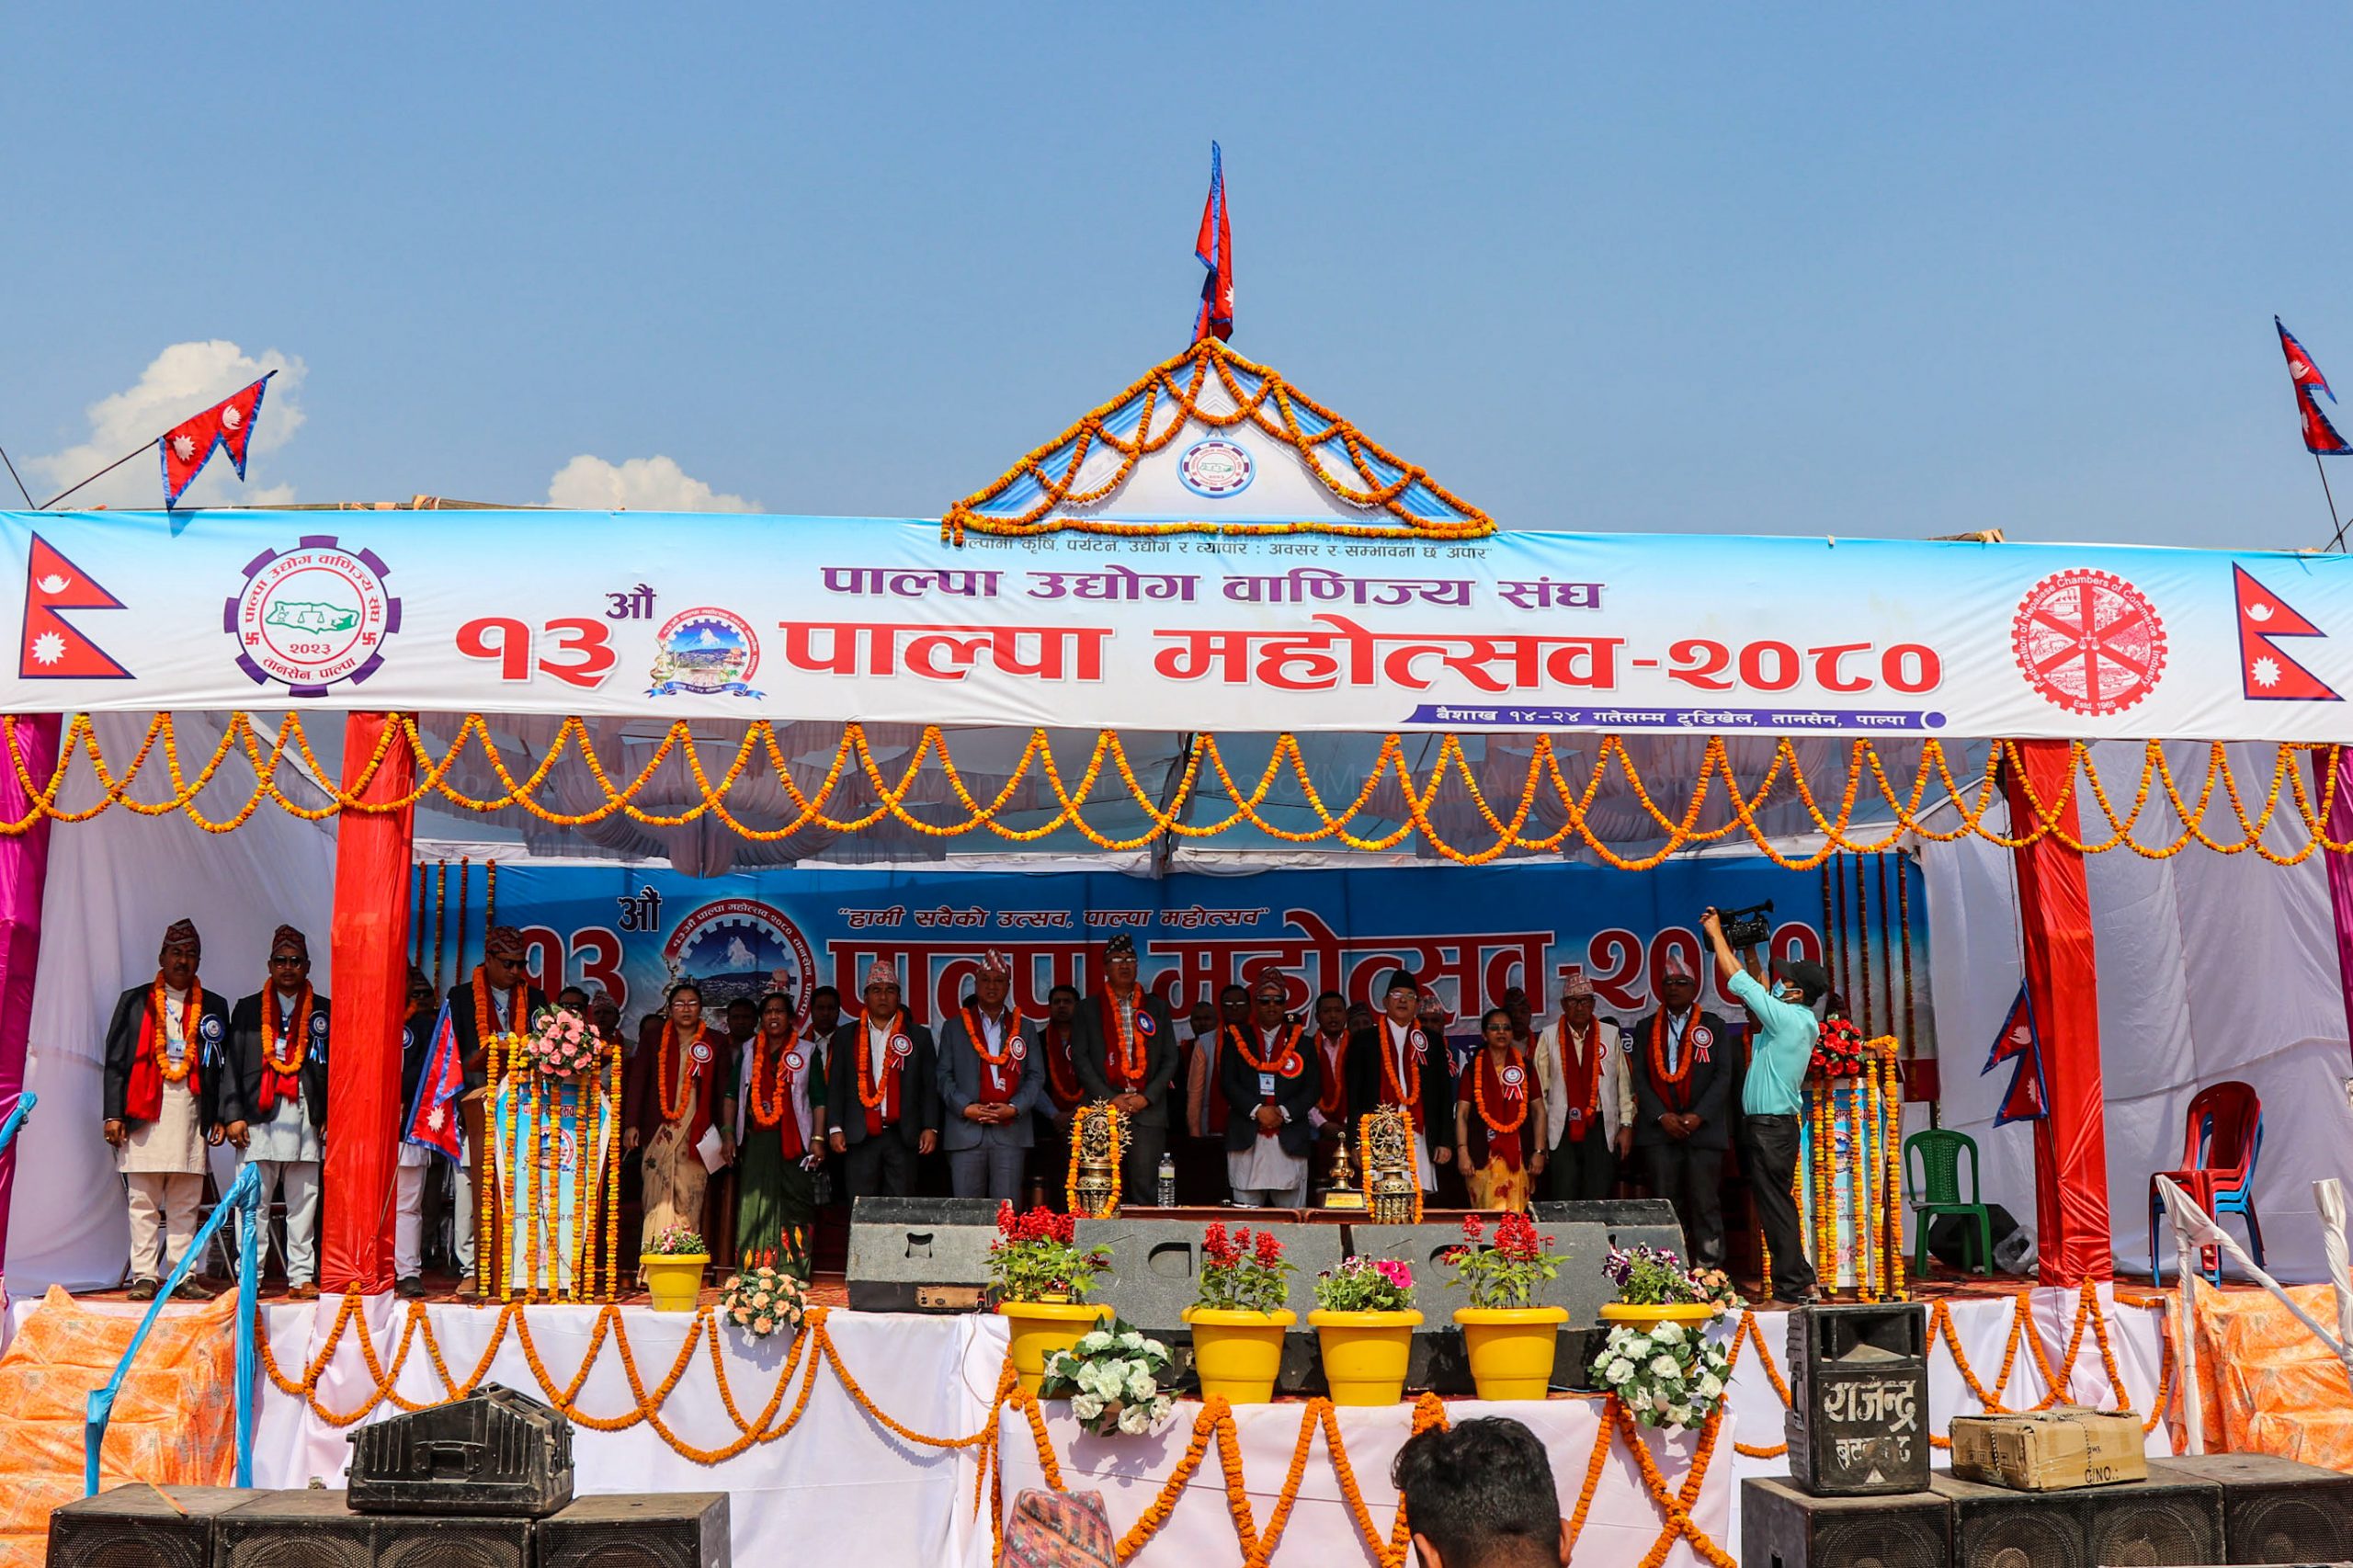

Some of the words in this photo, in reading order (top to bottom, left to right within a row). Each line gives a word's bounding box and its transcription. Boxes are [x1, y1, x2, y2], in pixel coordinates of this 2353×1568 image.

[1130, 538, 1171, 553] उद्योग
[1179, 541, 1189, 553] र
[1268, 544, 1319, 555] अवसर
[1345, 546, 1415, 557] सम्भावना
[1424, 546, 1438, 559] छ
[244, 580, 268, 624] पाल्पा
[267, 554, 313, 579] उद्योग
[318, 554, 374, 592] वाणिज्य
[369, 595, 381, 624] संघ
[821, 567, 1004, 597] पाल्पा
[1026, 564, 1201, 601] उद्योग
[1223, 567, 1476, 607] वाणिज्य
[1498, 576, 1606, 609] संघ
[2056, 575, 2109, 588] Chambers
[2110, 583, 2122, 593] of
[2021, 585, 2057, 619] Nepalese
[2122, 590, 2158, 637] Commerce
[2019, 619, 2029, 632] of
[290, 643, 332, 655] २०२३
[456, 617, 616, 687] १३
[779, 620, 1116, 682] पाल्पा
[1153, 613, 1940, 693] महोत्सव-२०८०
[319, 657, 358, 679] पाल्पा
[2019, 635, 2046, 688] Federation
[2140, 649, 2162, 687] Industry
[2074, 699, 2095, 710] Estd.
[2097, 699, 2117, 710] 1965
[1436, 706, 1498, 722] बैशाख
[1592, 710, 1666, 723] गतेसम्म
[1771, 713, 1843, 728] तानसेन,
[1855, 715, 1907, 726] पाल्पा
[697, 904, 725, 920] पाल्पा
[915, 905, 990, 926] सबैको
[997, 910, 1074, 928] उत्सव,
[1083, 910, 1153, 926] पाल्पा
